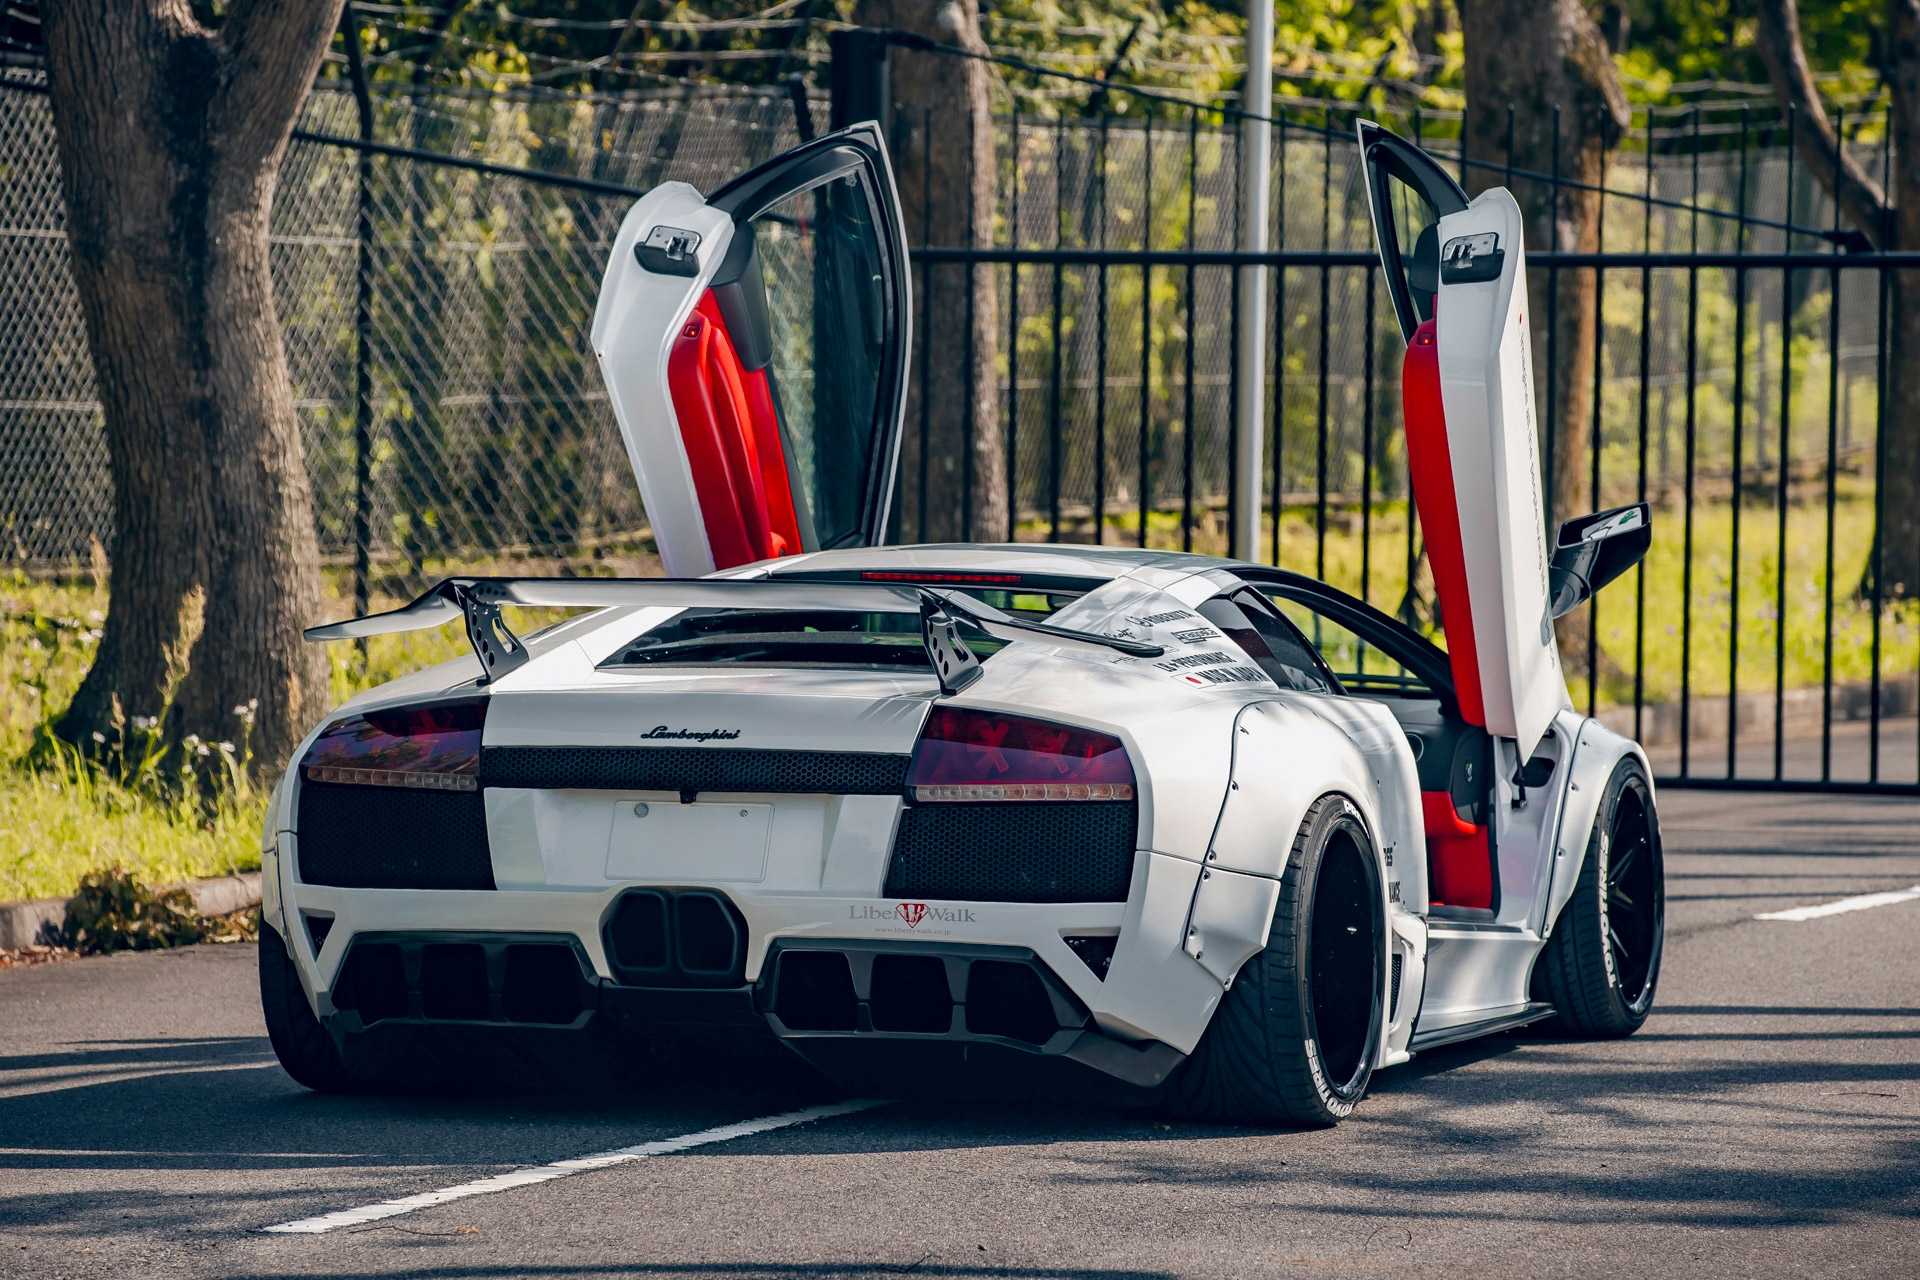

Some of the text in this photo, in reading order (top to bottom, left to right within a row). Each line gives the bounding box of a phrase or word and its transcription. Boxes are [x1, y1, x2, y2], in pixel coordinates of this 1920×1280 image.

[640, 725, 741, 742] Lamborghini
[925, 906, 977, 923] Walk
[874, 926, 952, 936] www.libertywalk.co.jp
